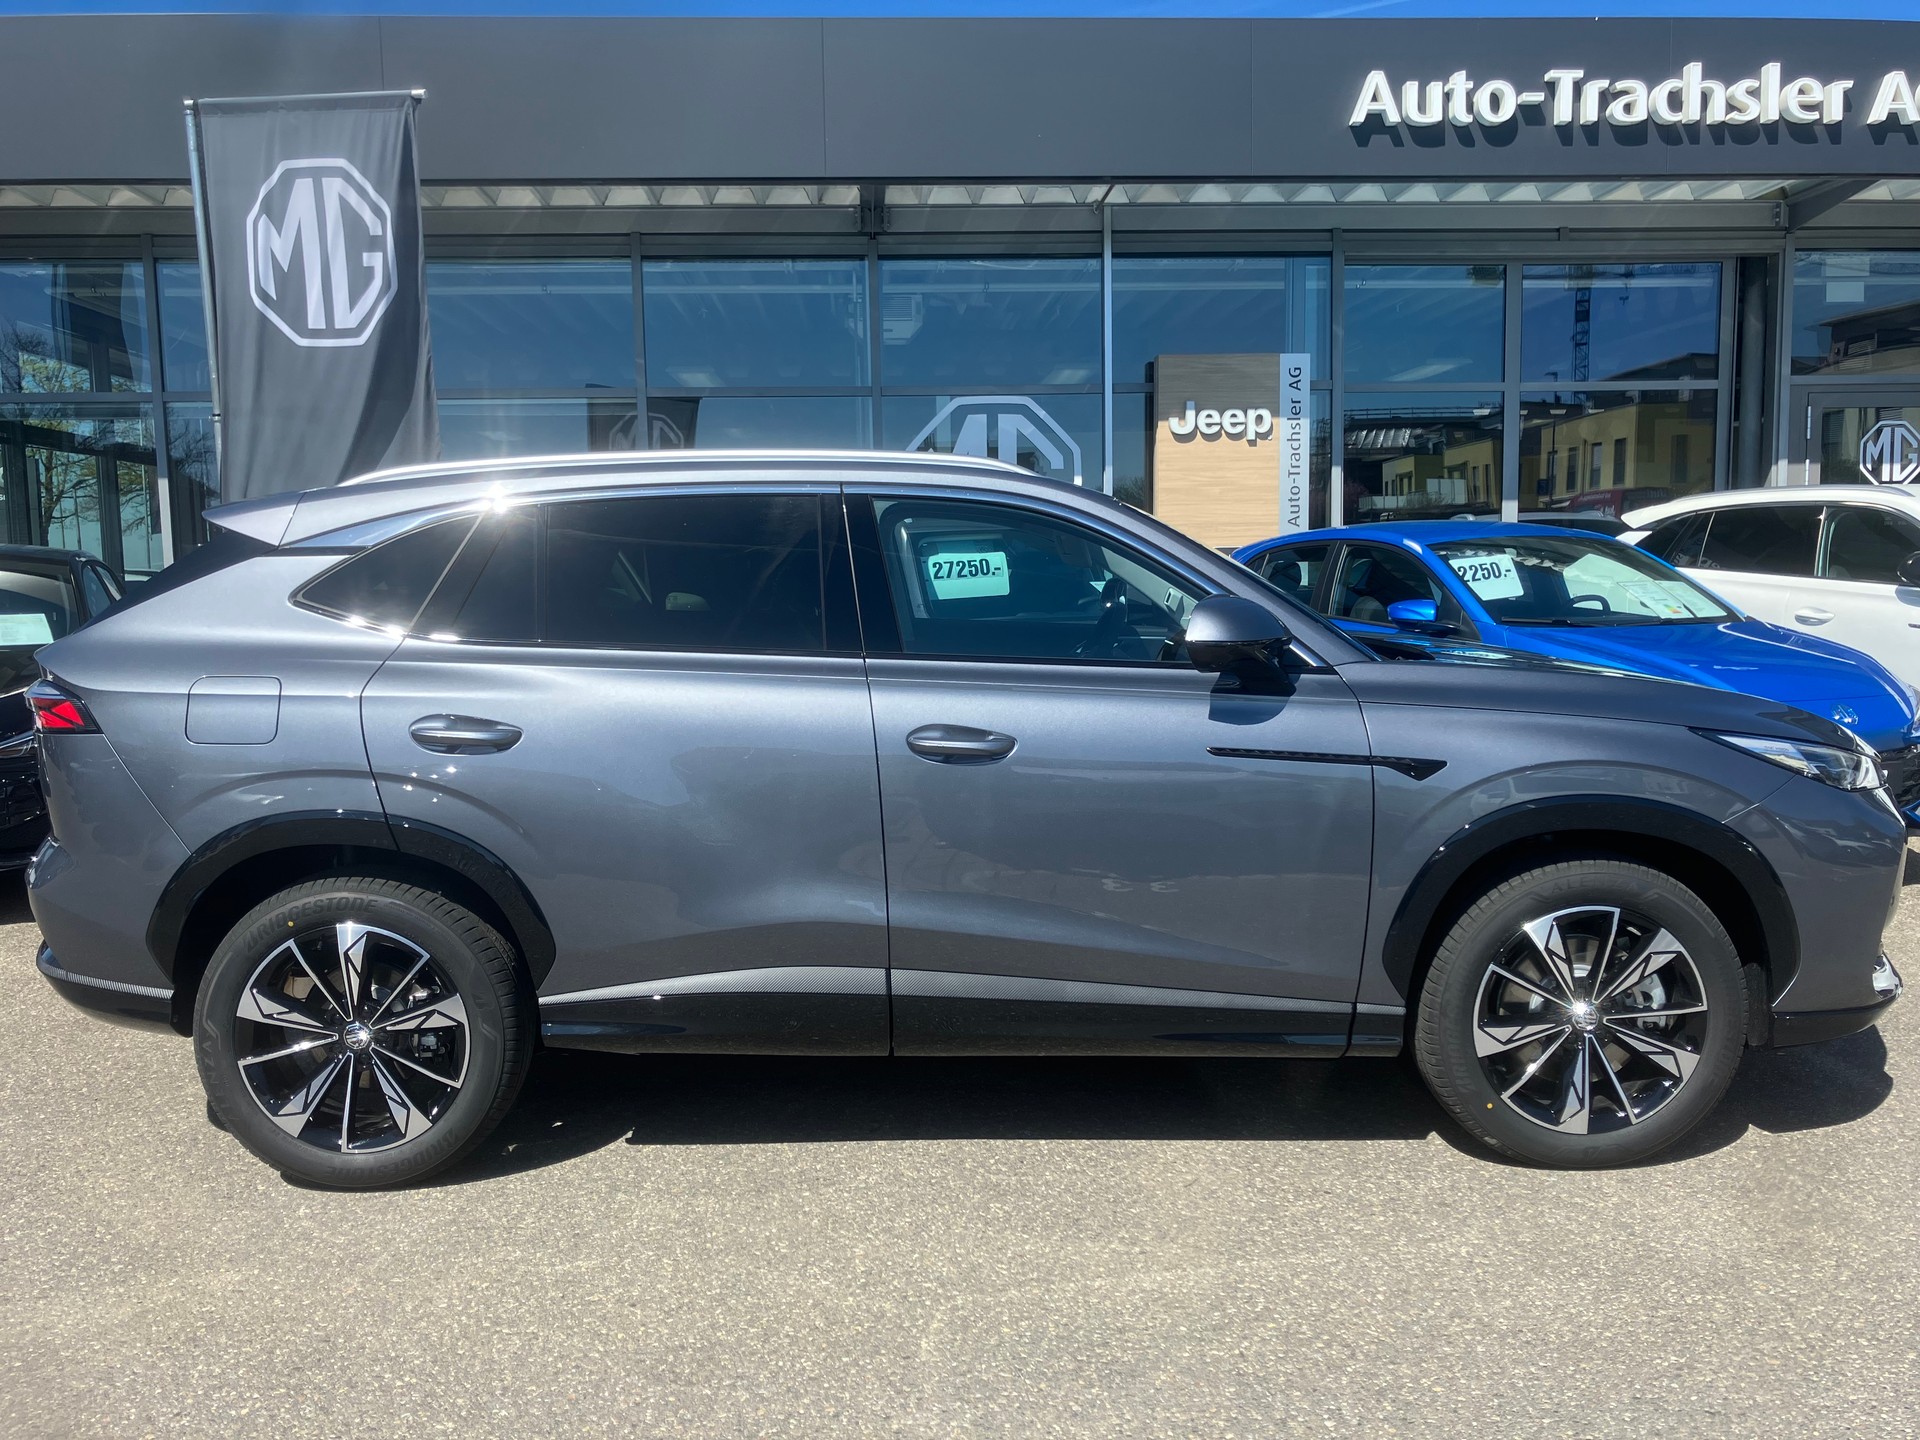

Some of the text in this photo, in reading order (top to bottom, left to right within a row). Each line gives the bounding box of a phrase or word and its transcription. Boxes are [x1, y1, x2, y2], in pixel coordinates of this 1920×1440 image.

[1349, 61, 1920, 126] Auto-Trachsler A
[257, 177, 384, 330] MG
[1168, 400, 1272, 440] Jeep
[1286, 366, 1302, 528] Auto-Trachsler AG
[1865, 426, 1918, 482] MG
[932, 557, 1002, 580] 27250.-
